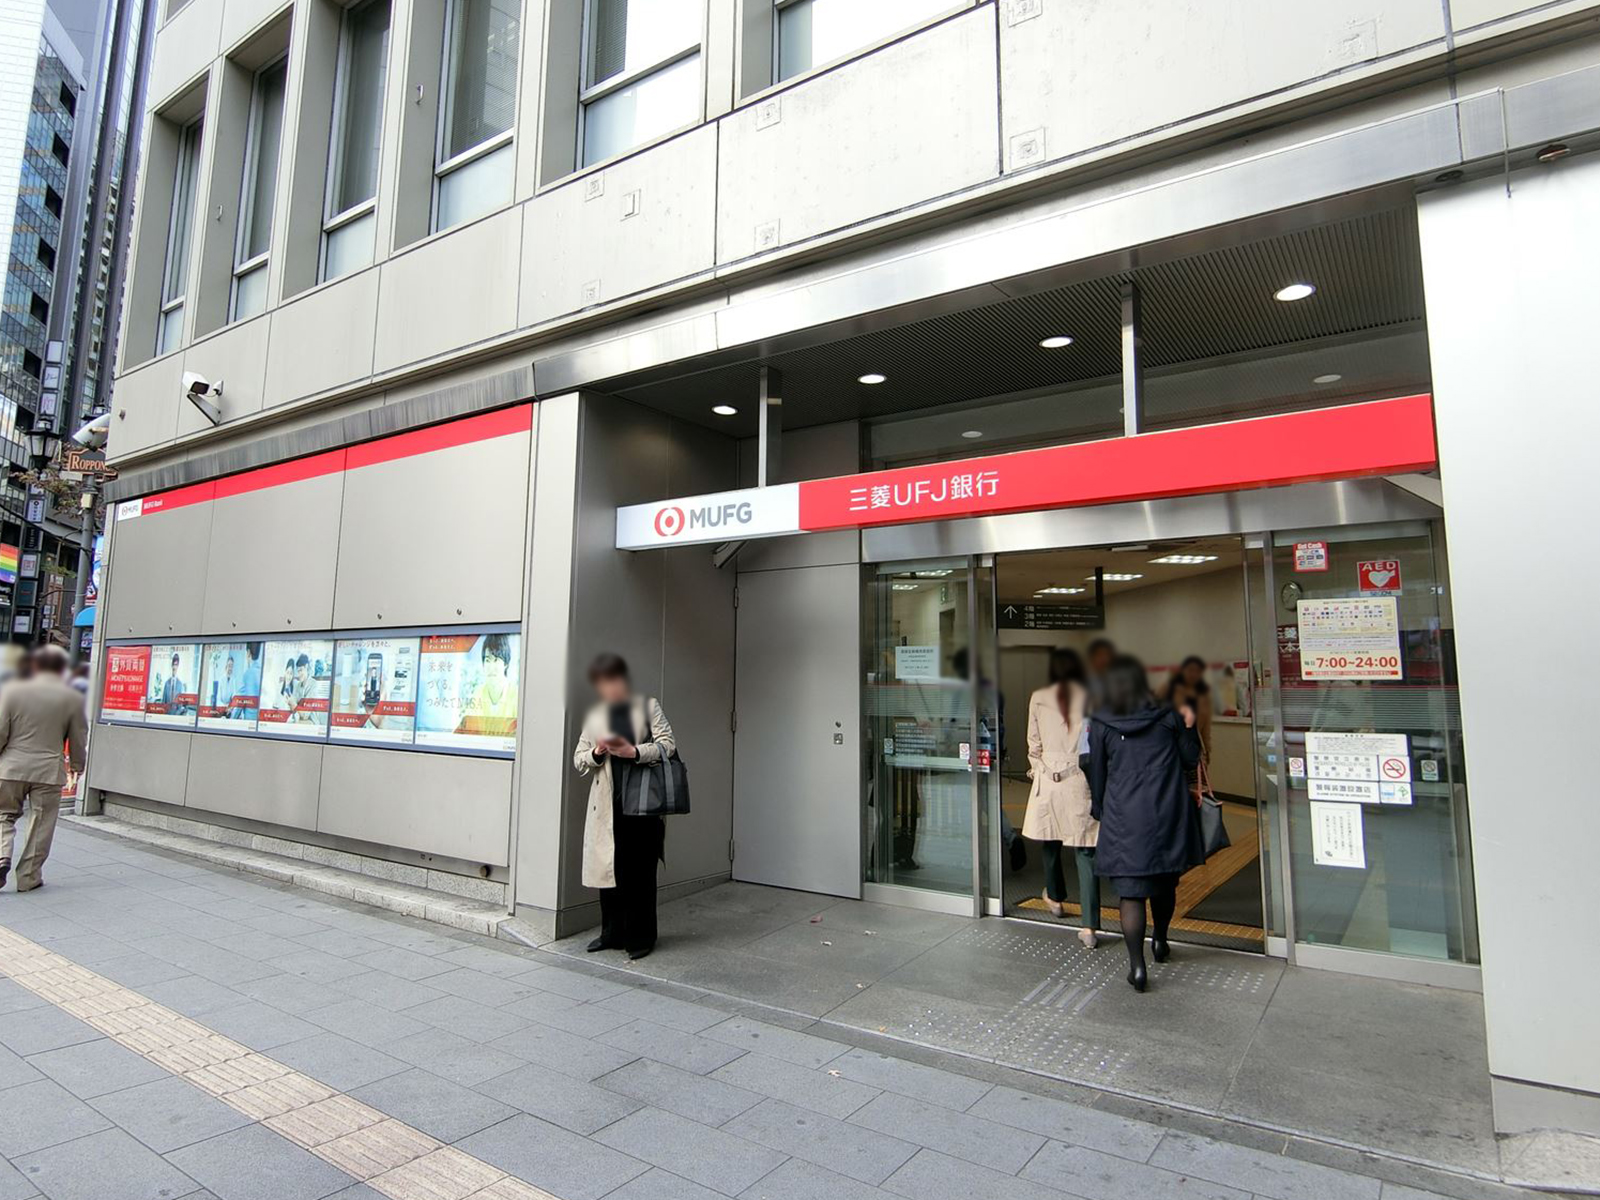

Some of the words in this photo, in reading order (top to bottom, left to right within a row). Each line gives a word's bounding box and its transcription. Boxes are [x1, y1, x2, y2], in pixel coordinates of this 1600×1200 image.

[71, 455, 109, 471] ROPPON
[848, 470, 1000, 513] 三菱UFJ銀行
[689, 501, 753, 530] MUFG
[1362, 561, 1396, 571] AED
